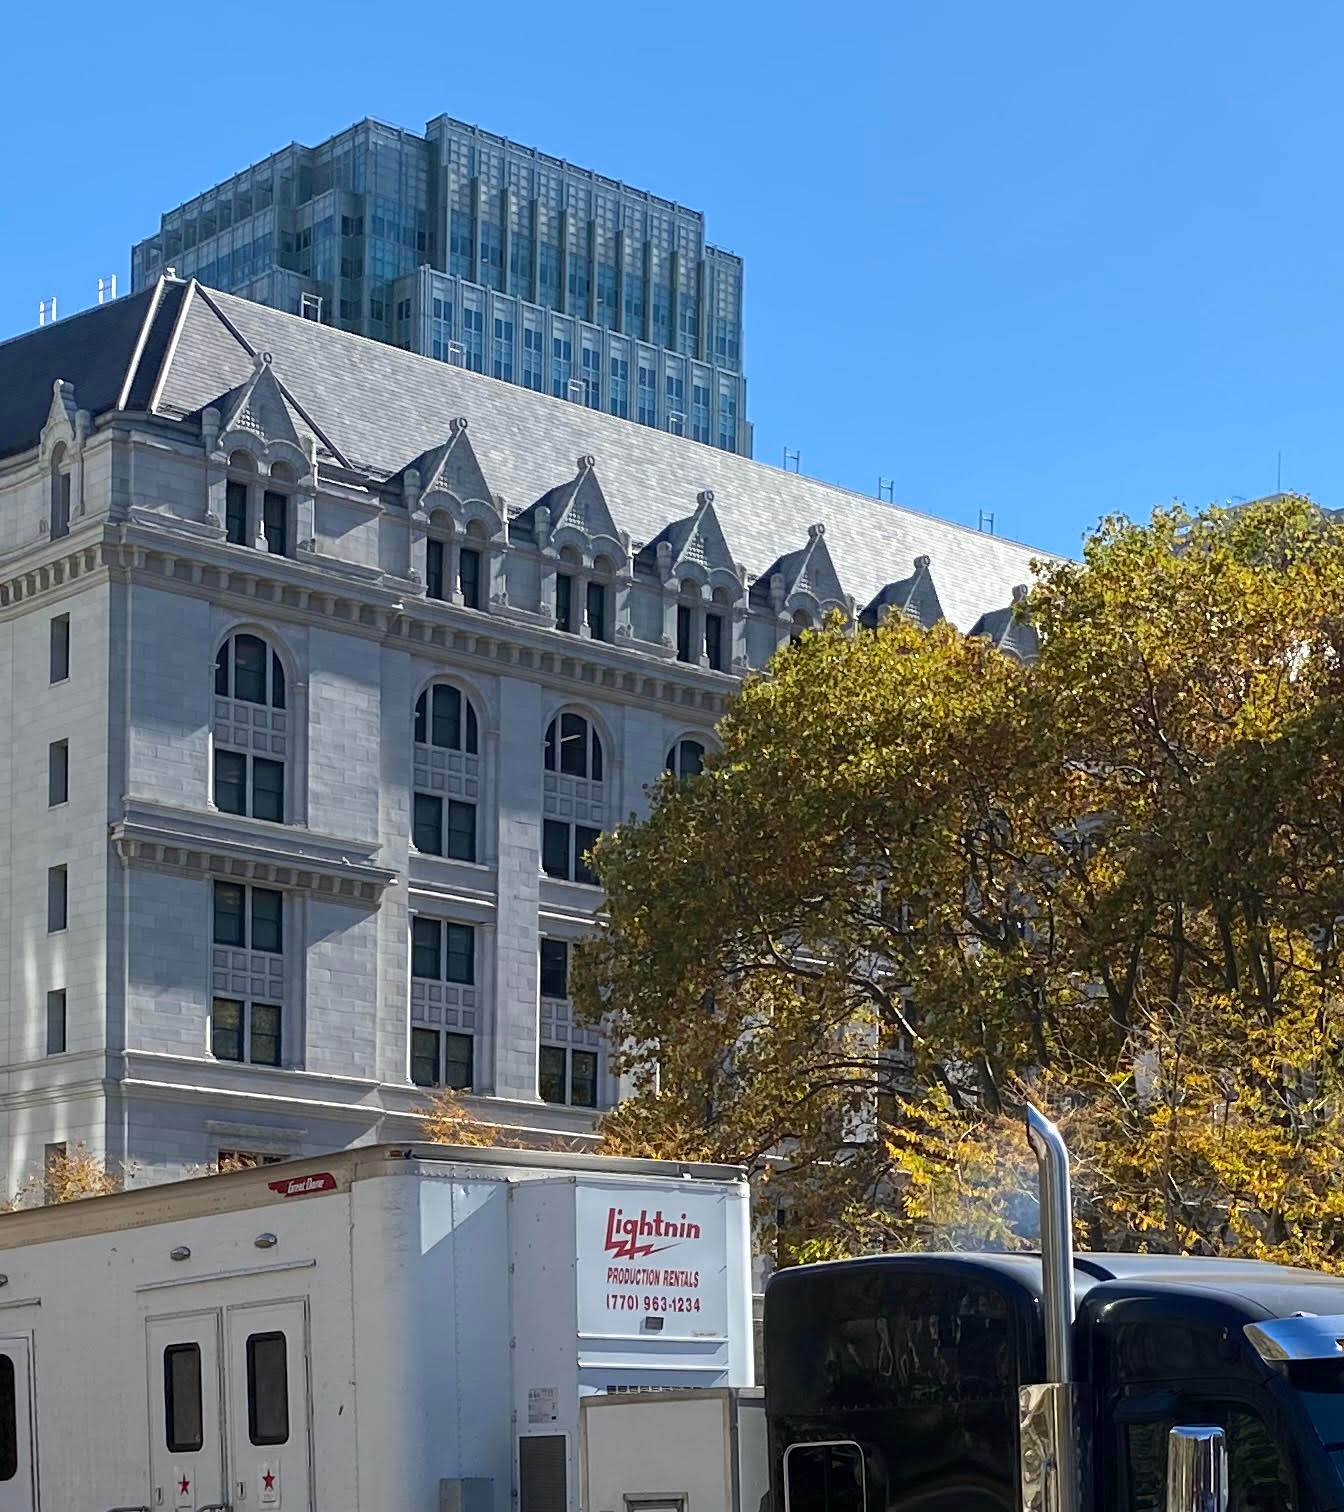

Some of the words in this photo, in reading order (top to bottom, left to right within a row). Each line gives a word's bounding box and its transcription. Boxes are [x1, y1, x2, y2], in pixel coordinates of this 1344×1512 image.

[604, 1207, 701, 1260] Lightnin
[607, 1267, 661, 1286] PRODUCTION
[663, 1270, 699, 1288] RENTALS
[606, 1294, 639, 1311] (770)
[644, 1296, 701, 1313] 963-1234
